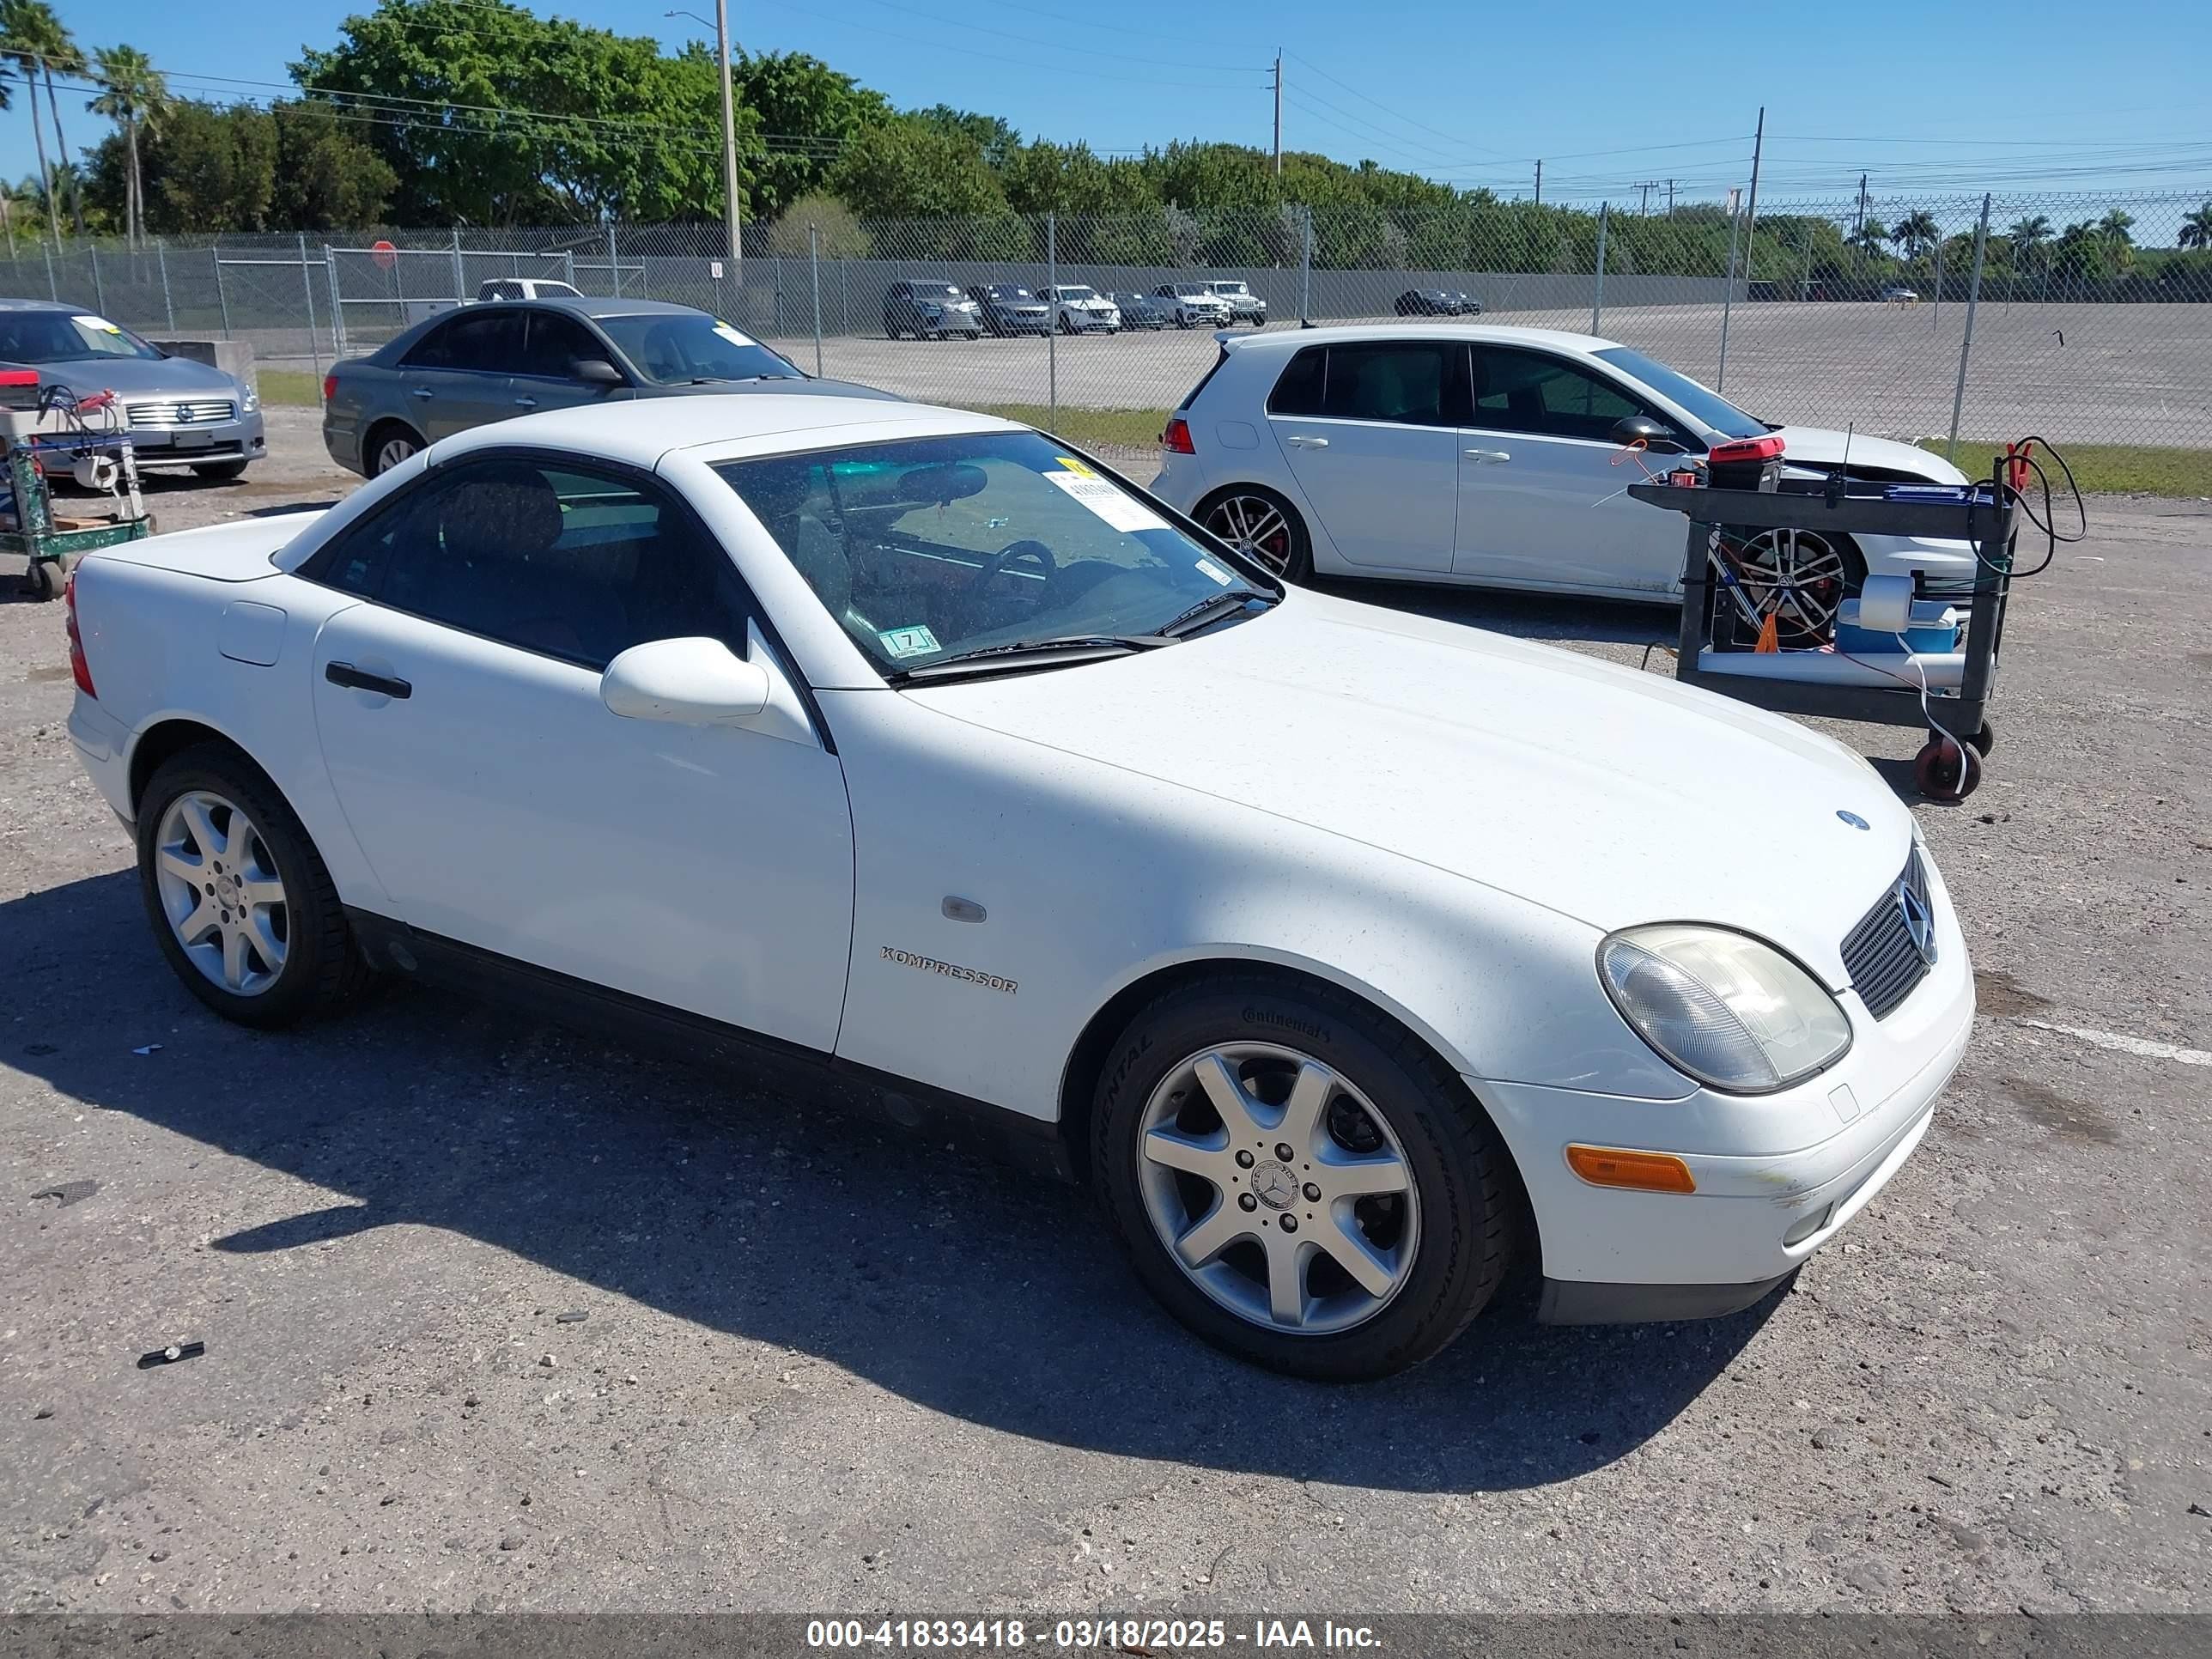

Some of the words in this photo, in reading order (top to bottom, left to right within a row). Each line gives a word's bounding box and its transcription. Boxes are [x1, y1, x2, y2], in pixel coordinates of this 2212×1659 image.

[714, 264, 720, 276] U
[900, 633, 913, 647] 7
[879, 946, 1018, 994] KOMPRESSOR
[1242, 1006, 1321, 1039] Continental
